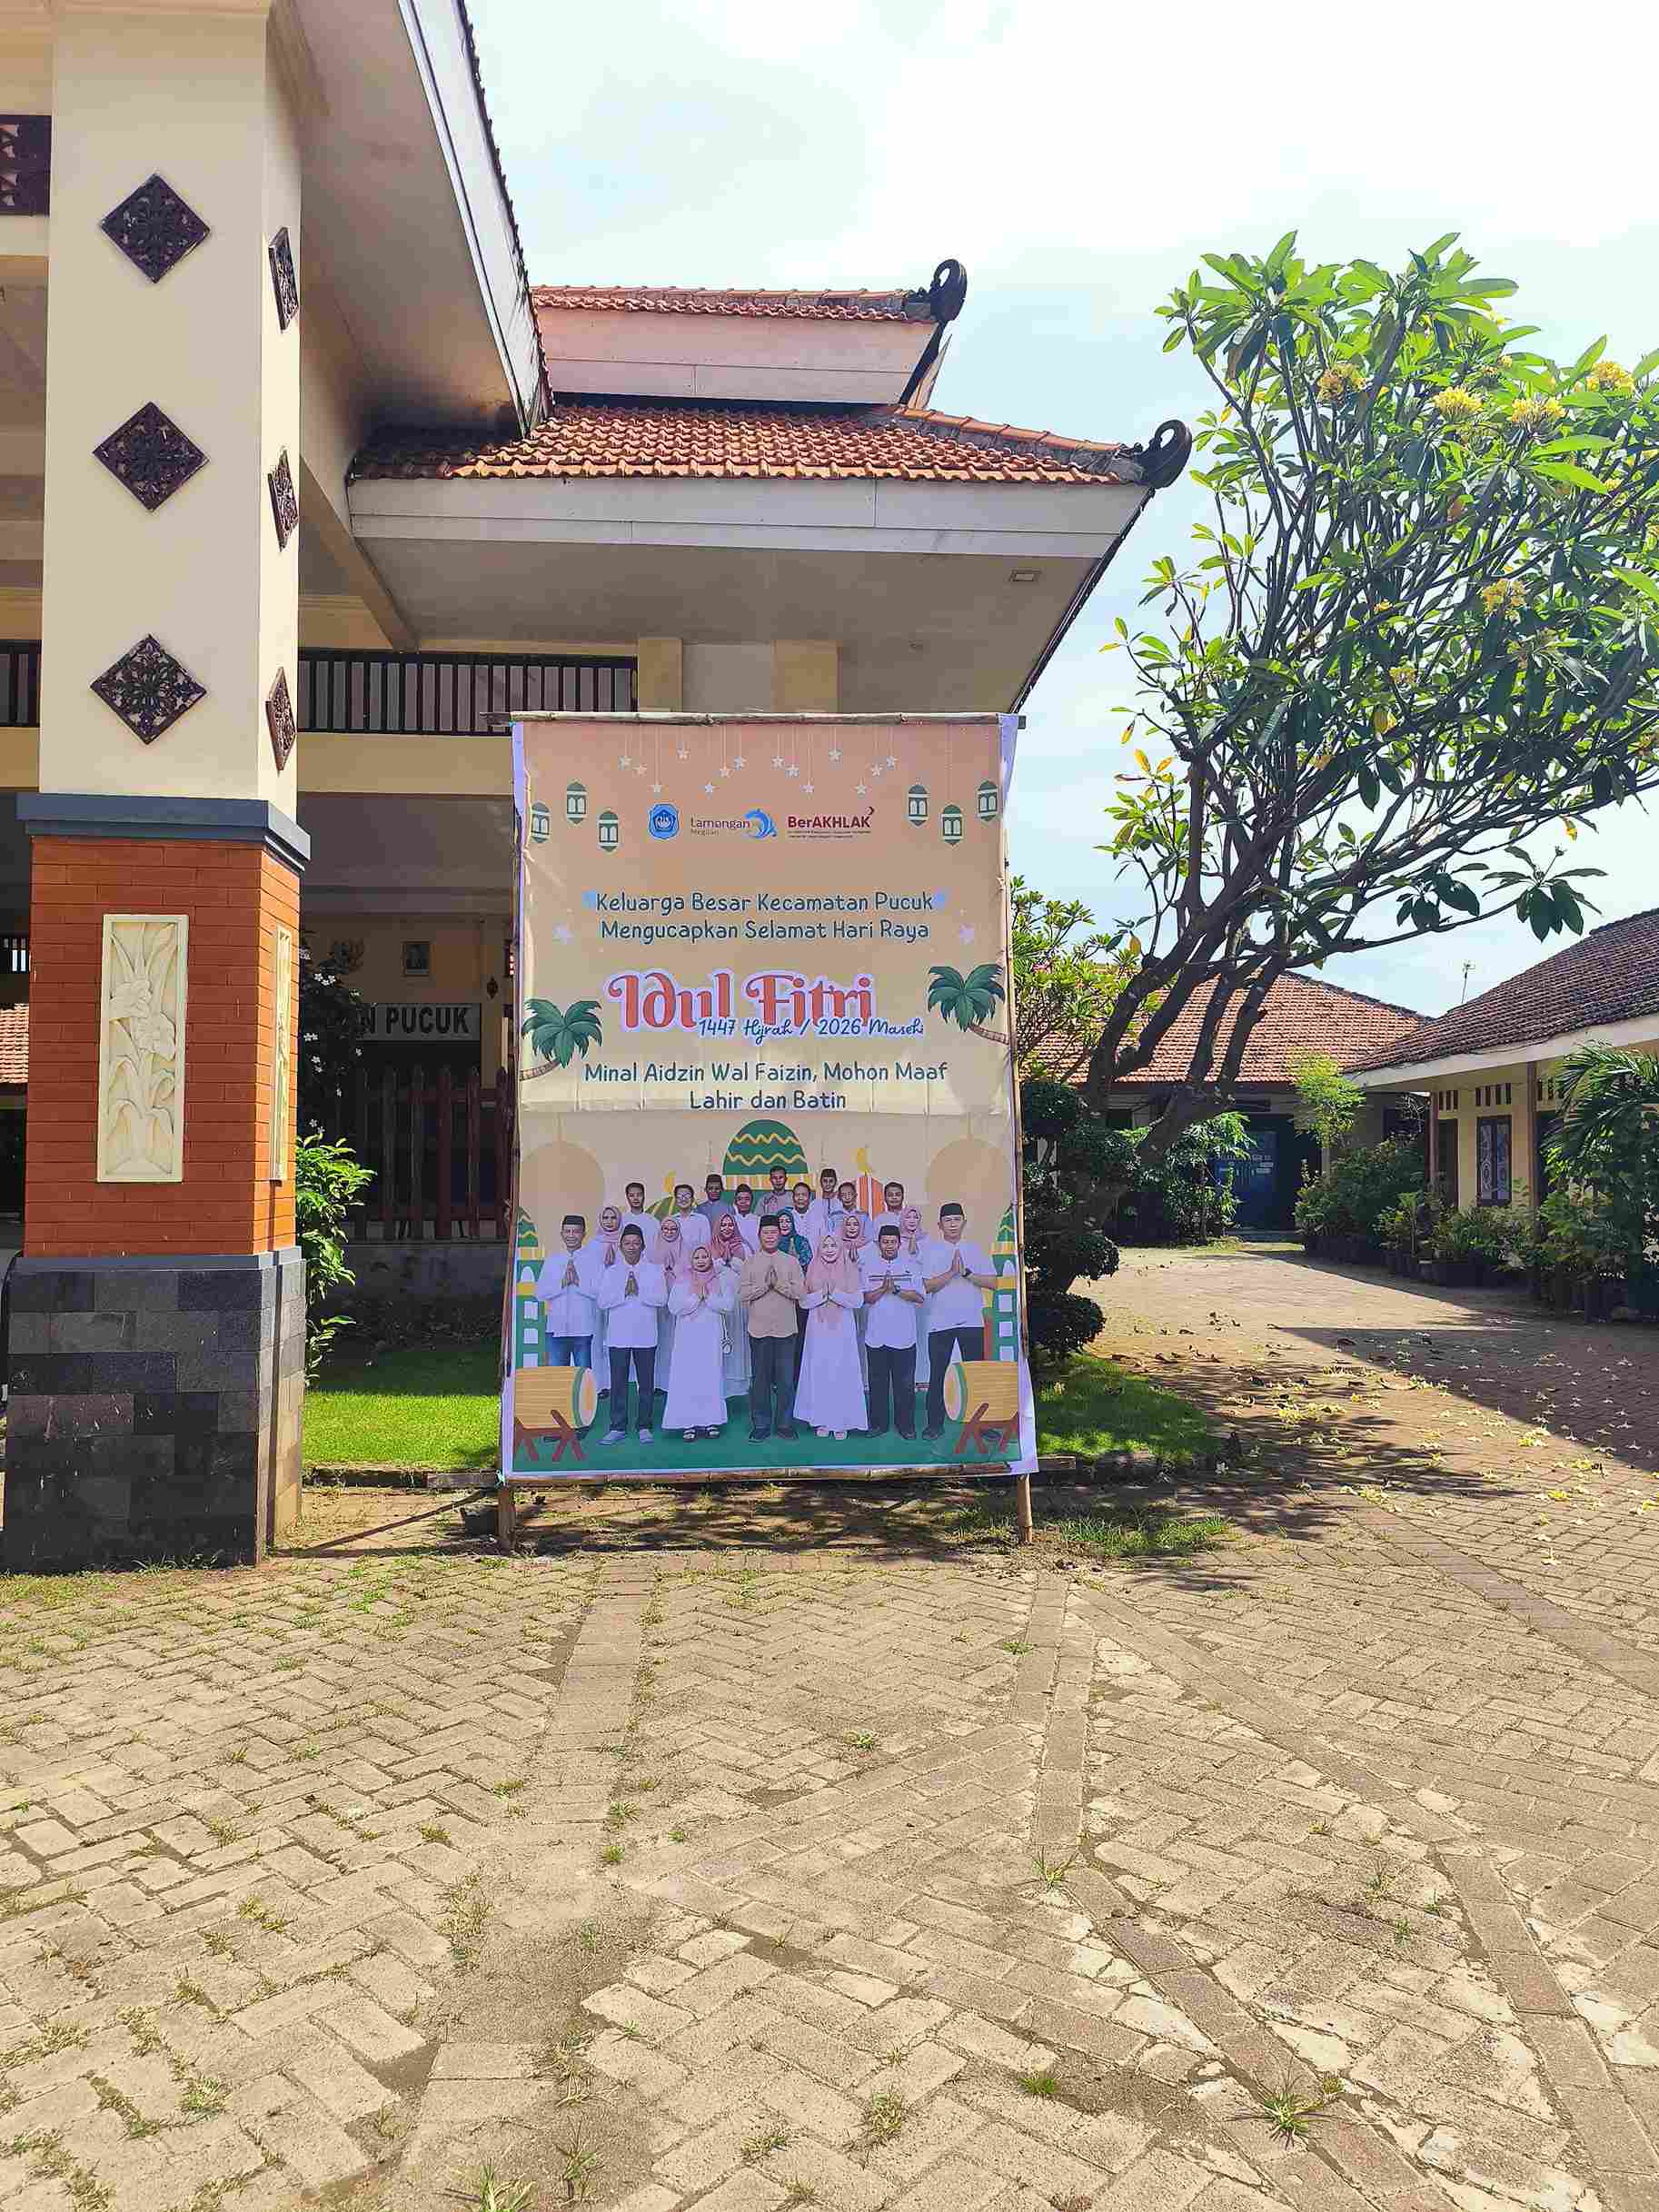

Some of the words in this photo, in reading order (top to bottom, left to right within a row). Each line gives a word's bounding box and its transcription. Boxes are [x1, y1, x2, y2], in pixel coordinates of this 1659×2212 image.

[690, 817, 751, 830] Lamongan
[787, 816, 871, 828] BerAKHLAK
[596, 893, 685, 916] Keluarga
[692, 893, 751, 911] Besar
[758, 893, 868, 911] Kecamatan
[875, 892, 934, 910] Pucuk
[601, 921, 738, 944] Mengucapkan
[745, 921, 827, 939] Selamat
[833, 921, 873, 938] Hari
[880, 921, 929, 943] Raya
[607, 972, 732, 1028] Idul
[745, 974, 873, 1027] Fitri
[385, 1007, 470, 1034] PUCUK
[699, 1018, 735, 1036] 1447
[820, 1018, 861, 1036] 2026
[869, 1018, 924, 1037] Masehi
[585, 1064, 638, 1081] Minal
[643, 1064, 704, 1081] Aidzin
[711, 1064, 749, 1081] Wal
[755, 1064, 818, 1084] Faizin,
[824, 1063, 889, 1081] Mohon
[896, 1062, 947, 1081] Maaf
[690, 1091, 743, 1110] Lahir
[750, 1091, 787, 1109] dan
[793, 1090, 846, 1108] Batin
